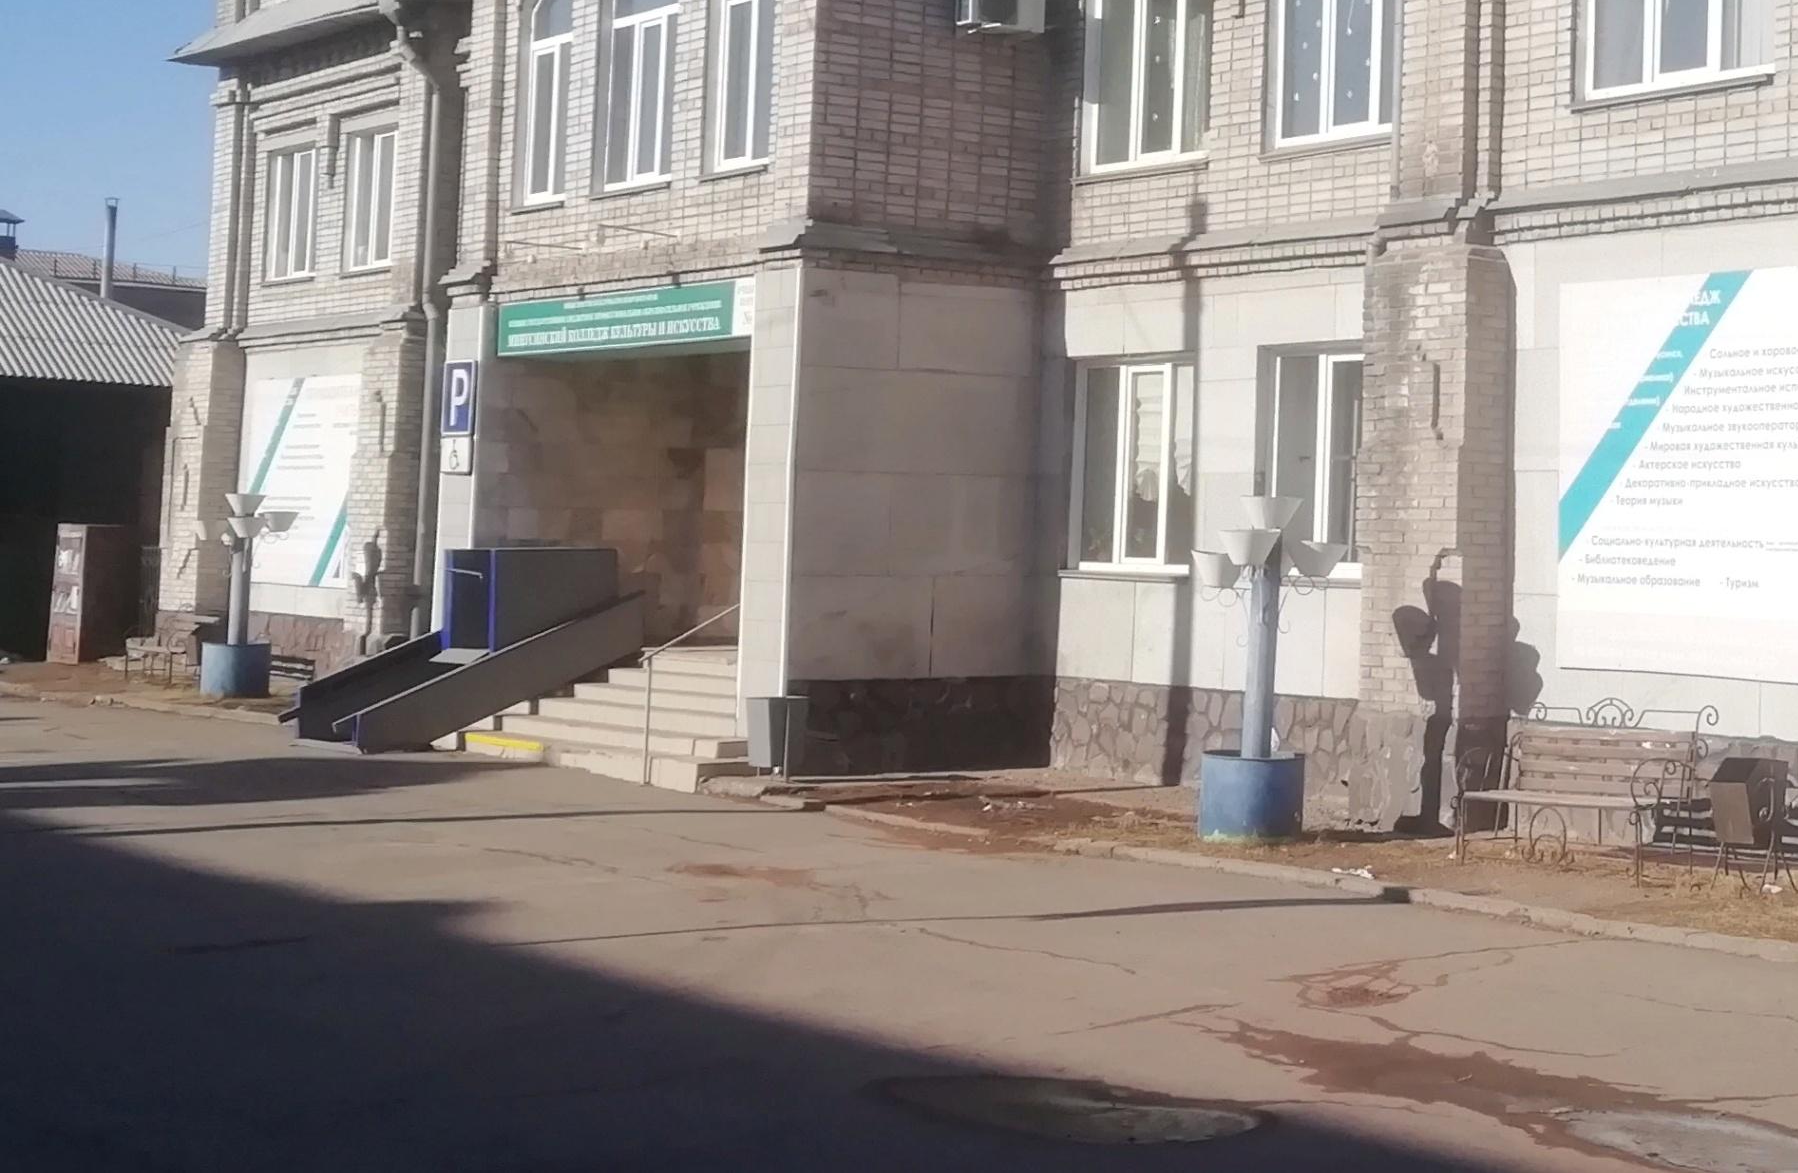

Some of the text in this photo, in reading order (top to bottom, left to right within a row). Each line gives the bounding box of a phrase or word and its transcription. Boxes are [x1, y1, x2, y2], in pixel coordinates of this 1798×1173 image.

[1710, 348, 1750, 359] Сольное
[1699, 367, 1764, 380] Музыкальное
[449, 368, 468, 426] P
[1683, 384, 1777, 397] Инструментальное
[1672, 403, 1720, 416] Народное
[1662, 422, 1724, 435] Музыкальное
[1649, 441, 1692, 454] Мировая
[1693, 441, 1775, 454] художественная
[1691, 460, 1742, 471] искусство
[1615, 494, 1684, 507] Теория музыки
[1698, 538, 1764, 549] деятельность
[1577, 573, 1638, 586] Музыкальное
[1640, 574, 1701, 589] образование
